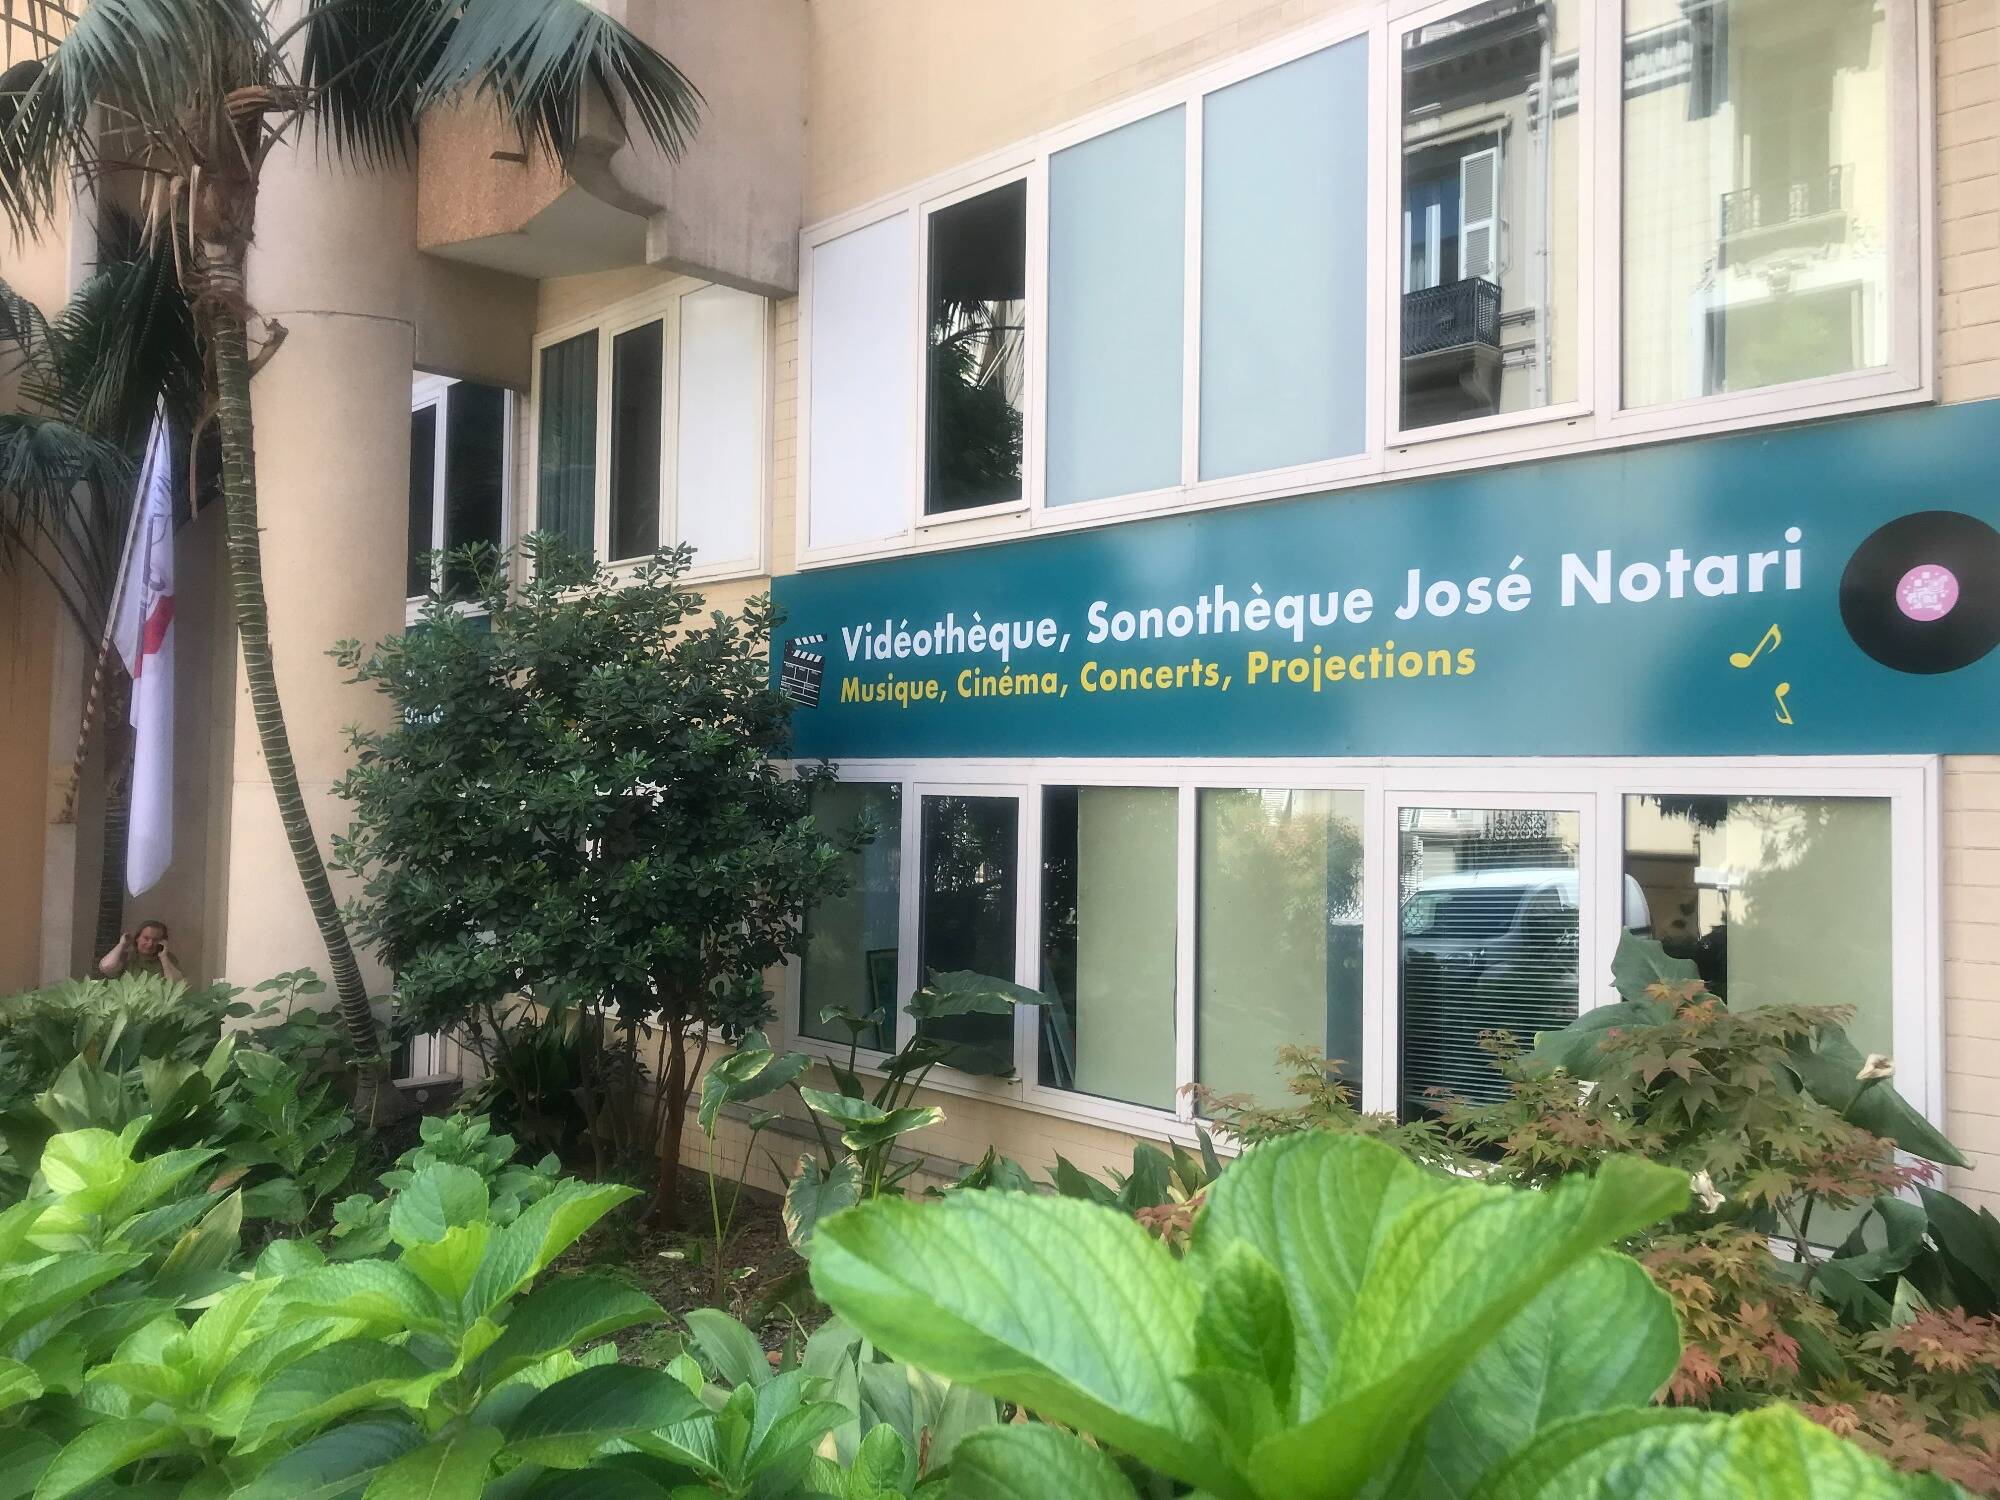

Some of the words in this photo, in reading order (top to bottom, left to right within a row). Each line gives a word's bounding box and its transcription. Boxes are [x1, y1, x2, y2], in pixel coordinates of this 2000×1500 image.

[841, 611, 1071, 664] Vidéothèque,
[1086, 582, 1374, 644] Sonothèque
[1394, 554, 1532, 621] José
[1560, 526, 1801, 607] Notari
[840, 676, 947, 708] Musique,
[957, 662, 1068, 698] Cinéma,
[1079, 659, 1233, 692] Concerts,
[1246, 640, 1476, 692] Projections
